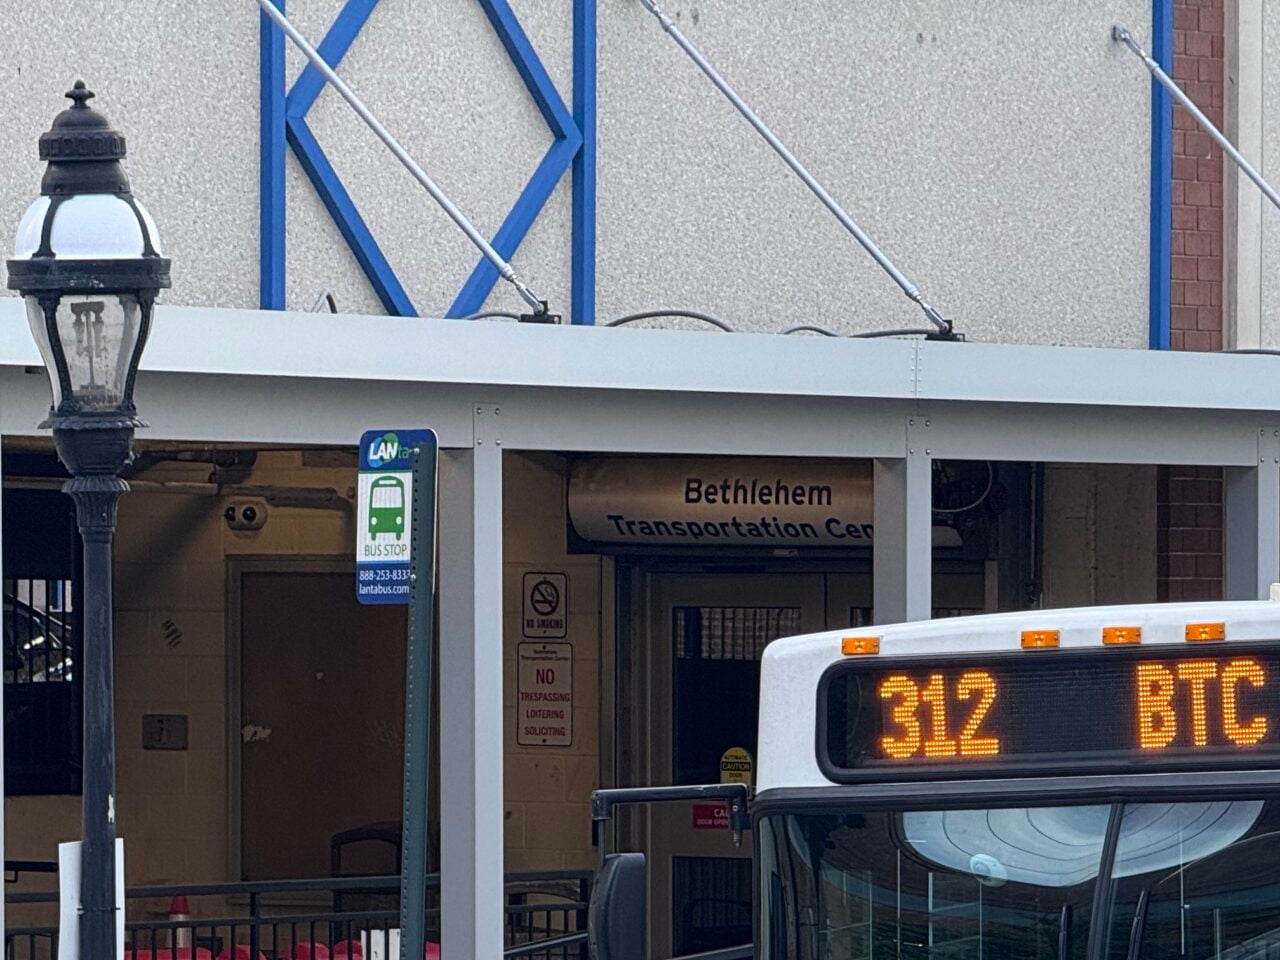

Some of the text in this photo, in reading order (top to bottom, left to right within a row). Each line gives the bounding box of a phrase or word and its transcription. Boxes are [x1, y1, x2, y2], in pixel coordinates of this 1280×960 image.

[684, 478, 832, 506] Bethlehem
[607, 514, 818, 540] Transportation
[364, 543, 408, 557] BUS STOP
[359, 583, 410, 595] lantabus.com
[526, 618, 564, 629] NO SMOKING
[536, 668, 555, 685] NO
[520, 692, 571, 702] TRESPASSING
[526, 709, 565, 720] LOITERING
[879, 659, 1268, 759] 312 BTC
[524, 726, 567, 736] SOLICITING
[722, 762, 750, 770] CAUTION
